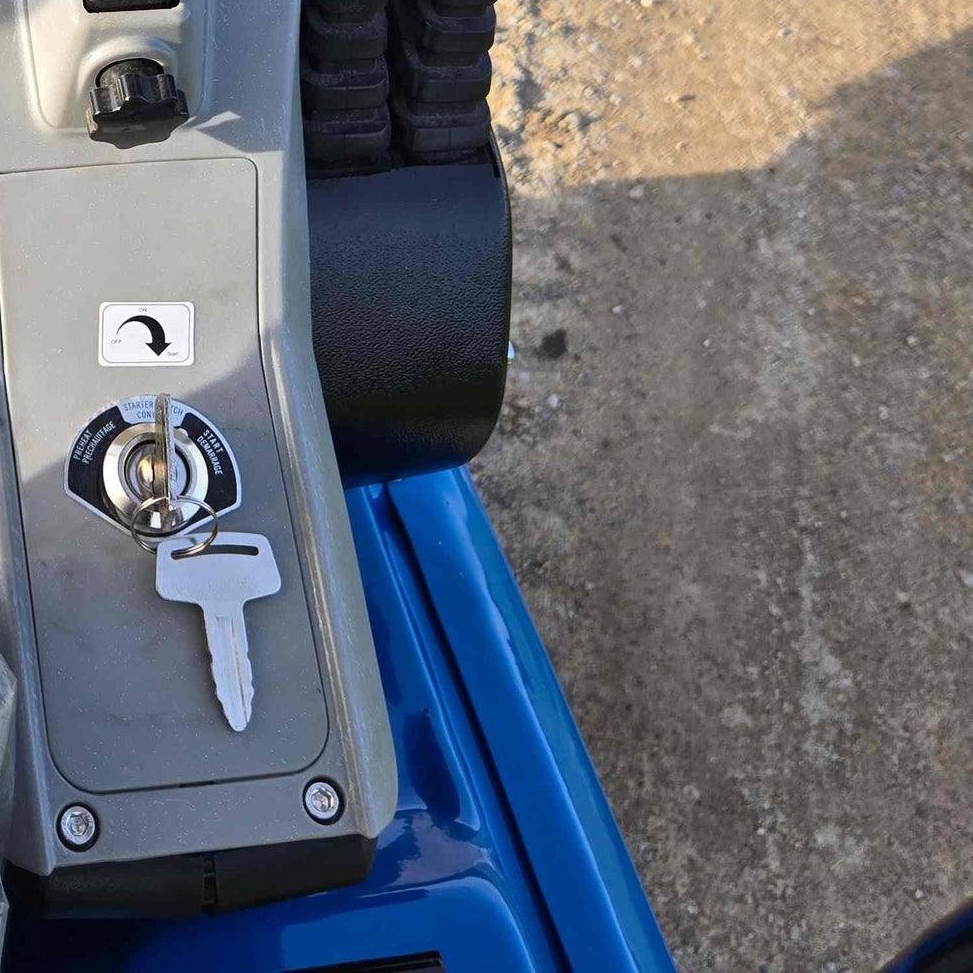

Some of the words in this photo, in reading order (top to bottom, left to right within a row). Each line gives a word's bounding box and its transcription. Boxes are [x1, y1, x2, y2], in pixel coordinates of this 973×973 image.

[123, 401, 154, 412] STARTER
[73, 429, 92, 460] PREHEAT
[82, 420, 116, 464] PRECHAUFFAGE
[195, 435, 224, 476] DEMARRAGE
[203, 429, 223, 453] START
